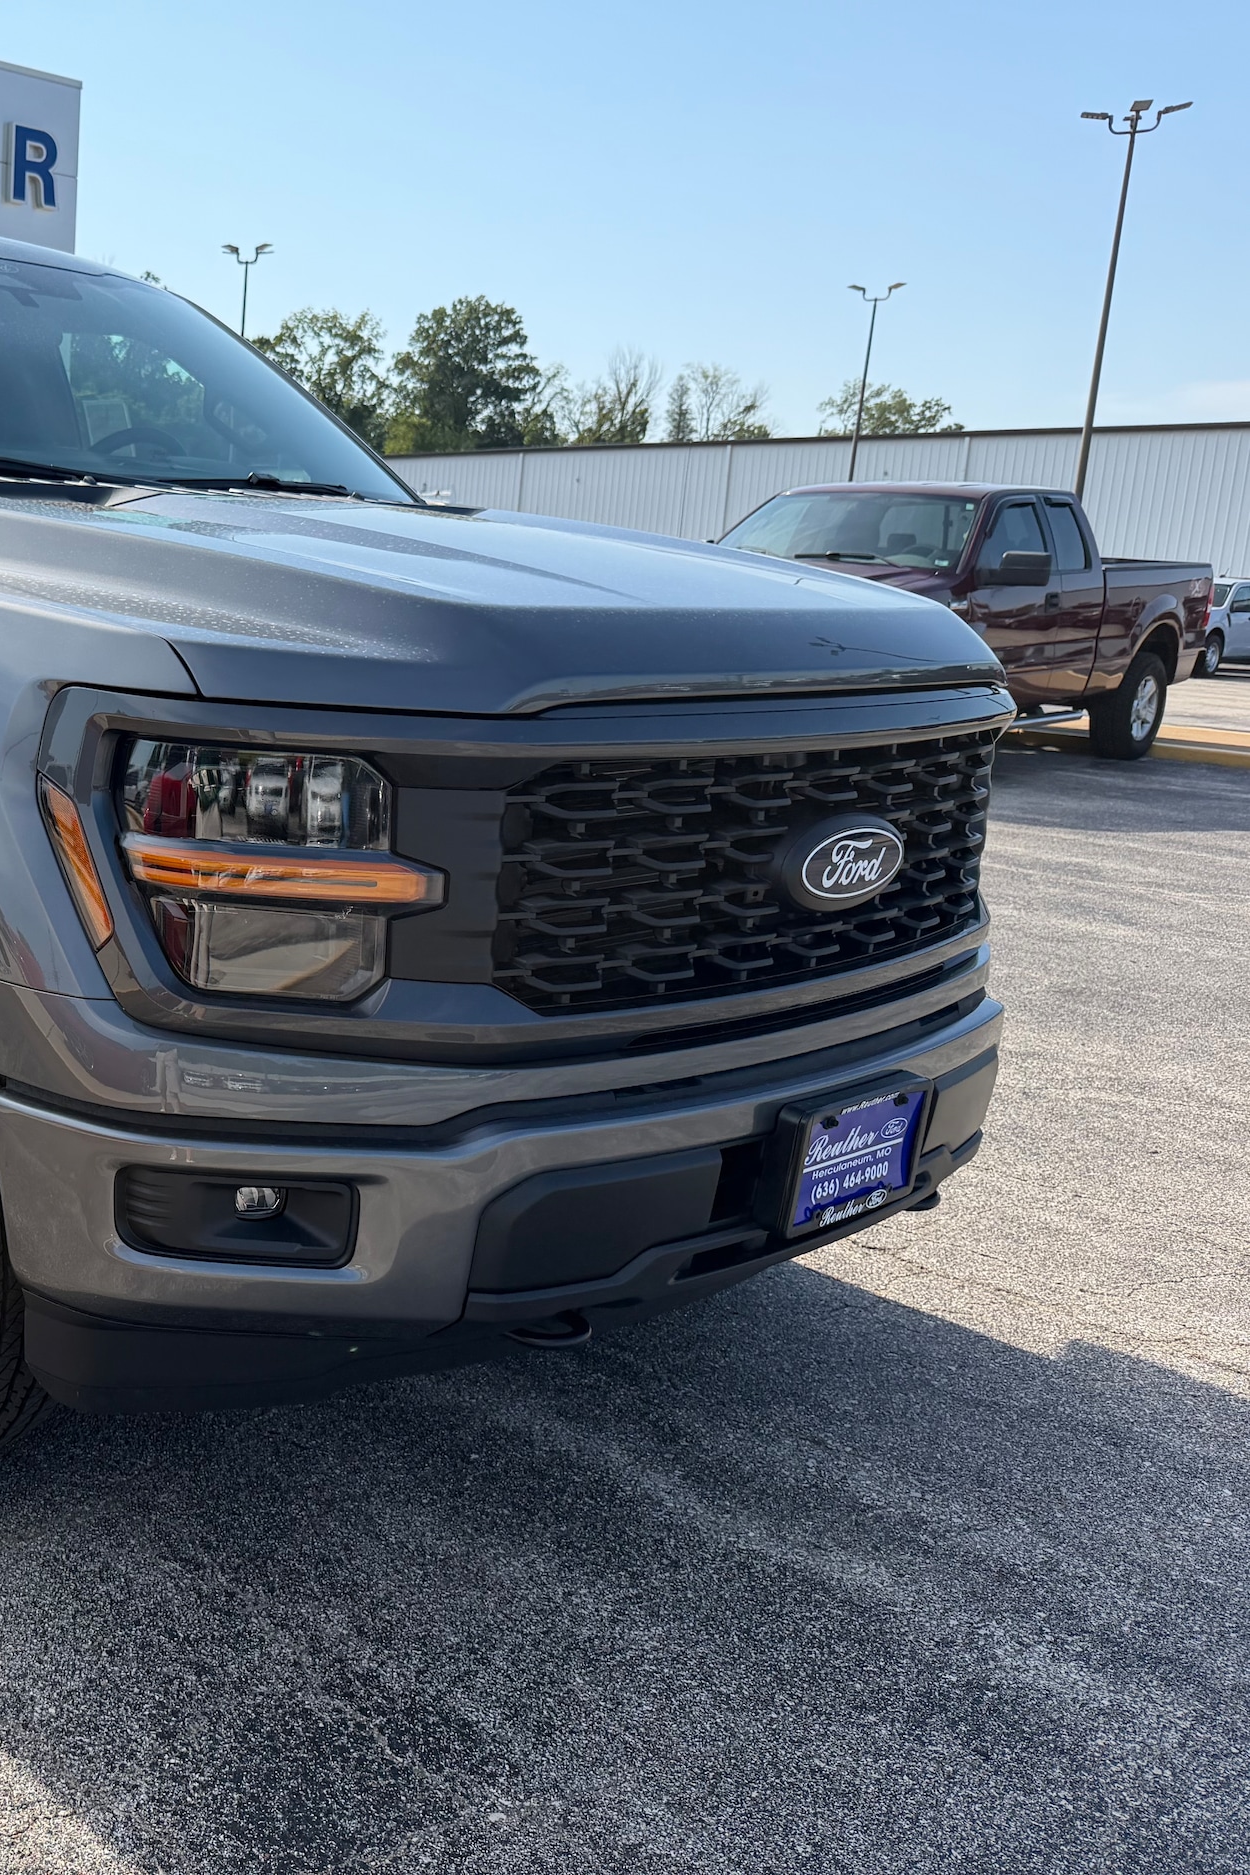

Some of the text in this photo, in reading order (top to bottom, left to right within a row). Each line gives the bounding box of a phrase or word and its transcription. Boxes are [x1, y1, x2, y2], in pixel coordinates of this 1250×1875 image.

[822, 838, 887, 888] Ford
[804, 1125, 879, 1166] Reuther
[812, 1147, 892, 1180] Herculaneum, MO
[811, 1161, 889, 1205] (636) 464-9000
[819, 1199, 865, 1227] Reuther
